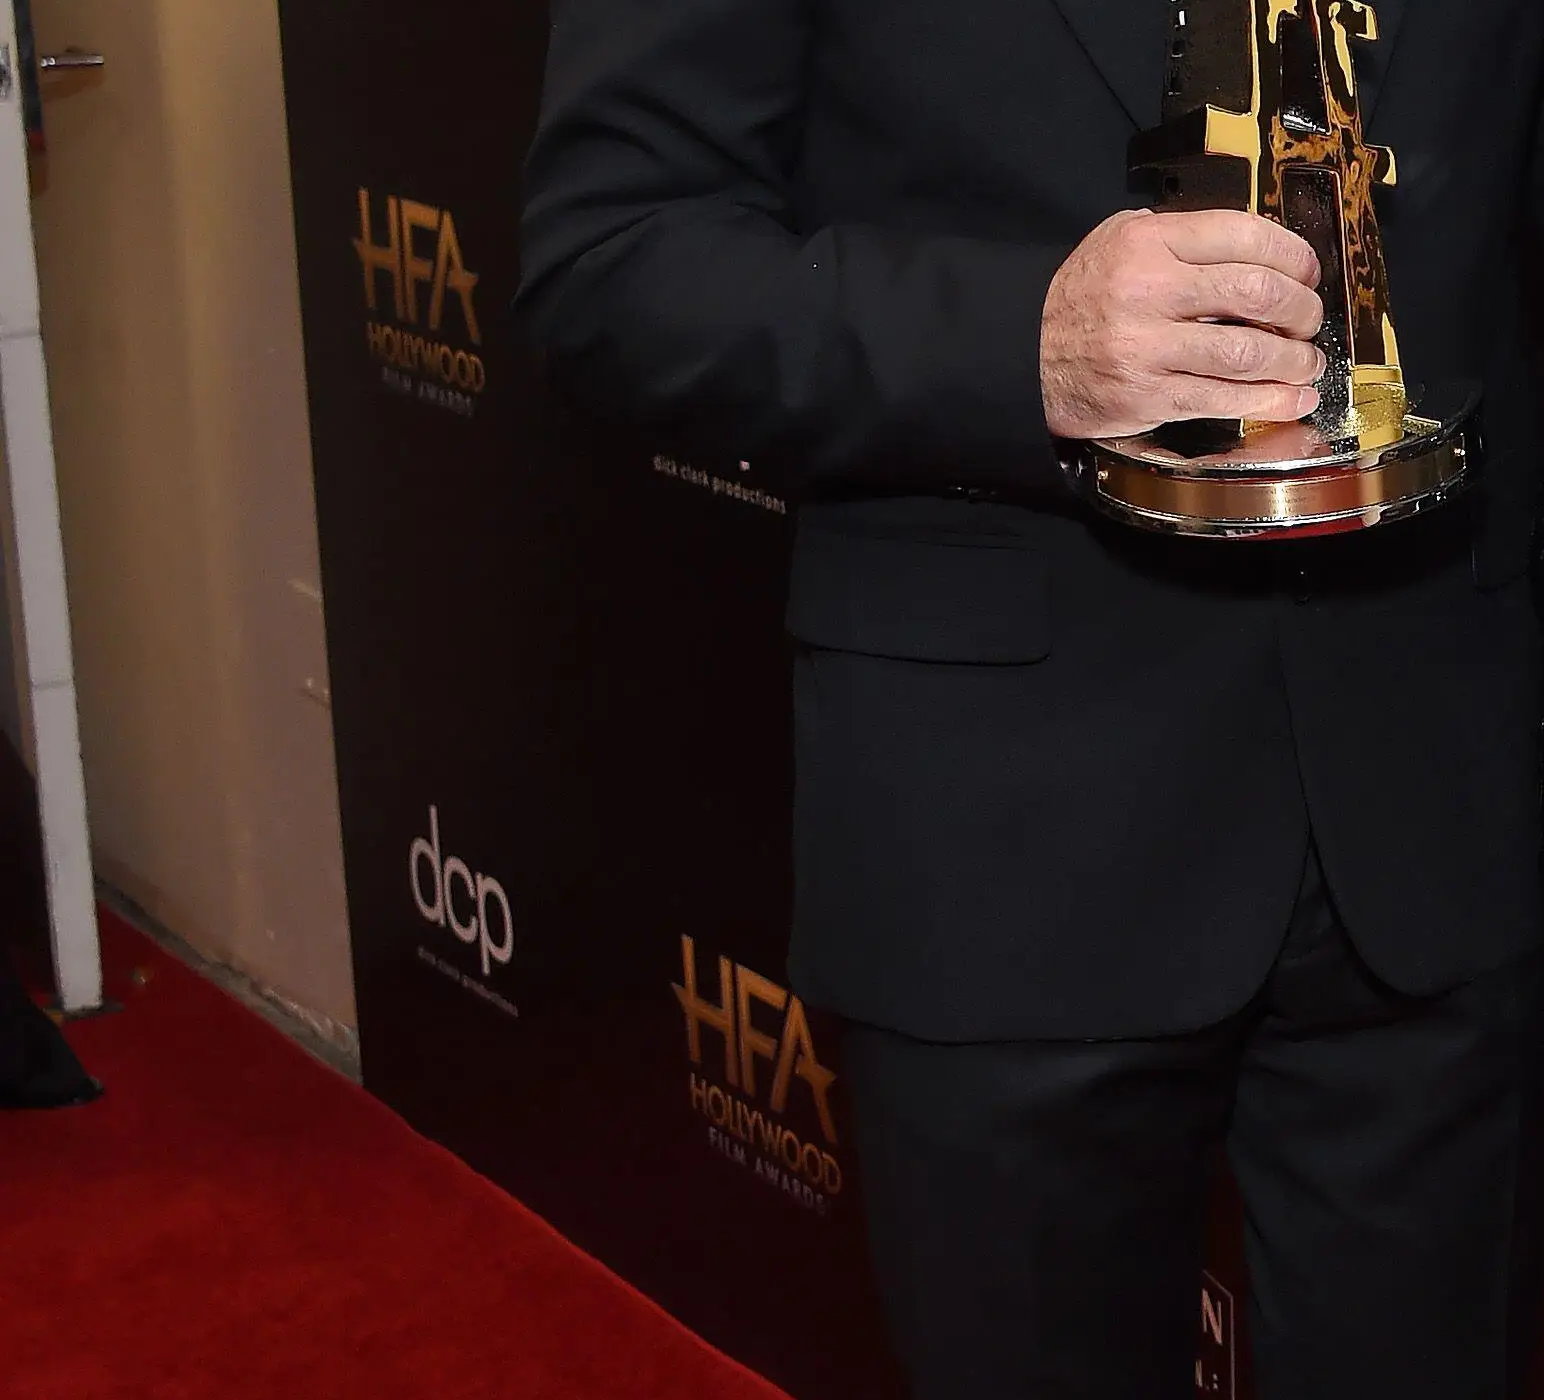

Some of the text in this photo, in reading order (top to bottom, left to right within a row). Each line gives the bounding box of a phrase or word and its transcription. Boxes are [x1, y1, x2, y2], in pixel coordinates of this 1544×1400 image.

[353, 185, 481, 346] HFA
[365, 321, 486, 393] HOLLYWOOD
[408, 804, 515, 976] dcp
[670, 933, 838, 1146] HFA
[690, 1072, 842, 1196] HOLLYWOOD
[708, 1126, 747, 1166] FILM
